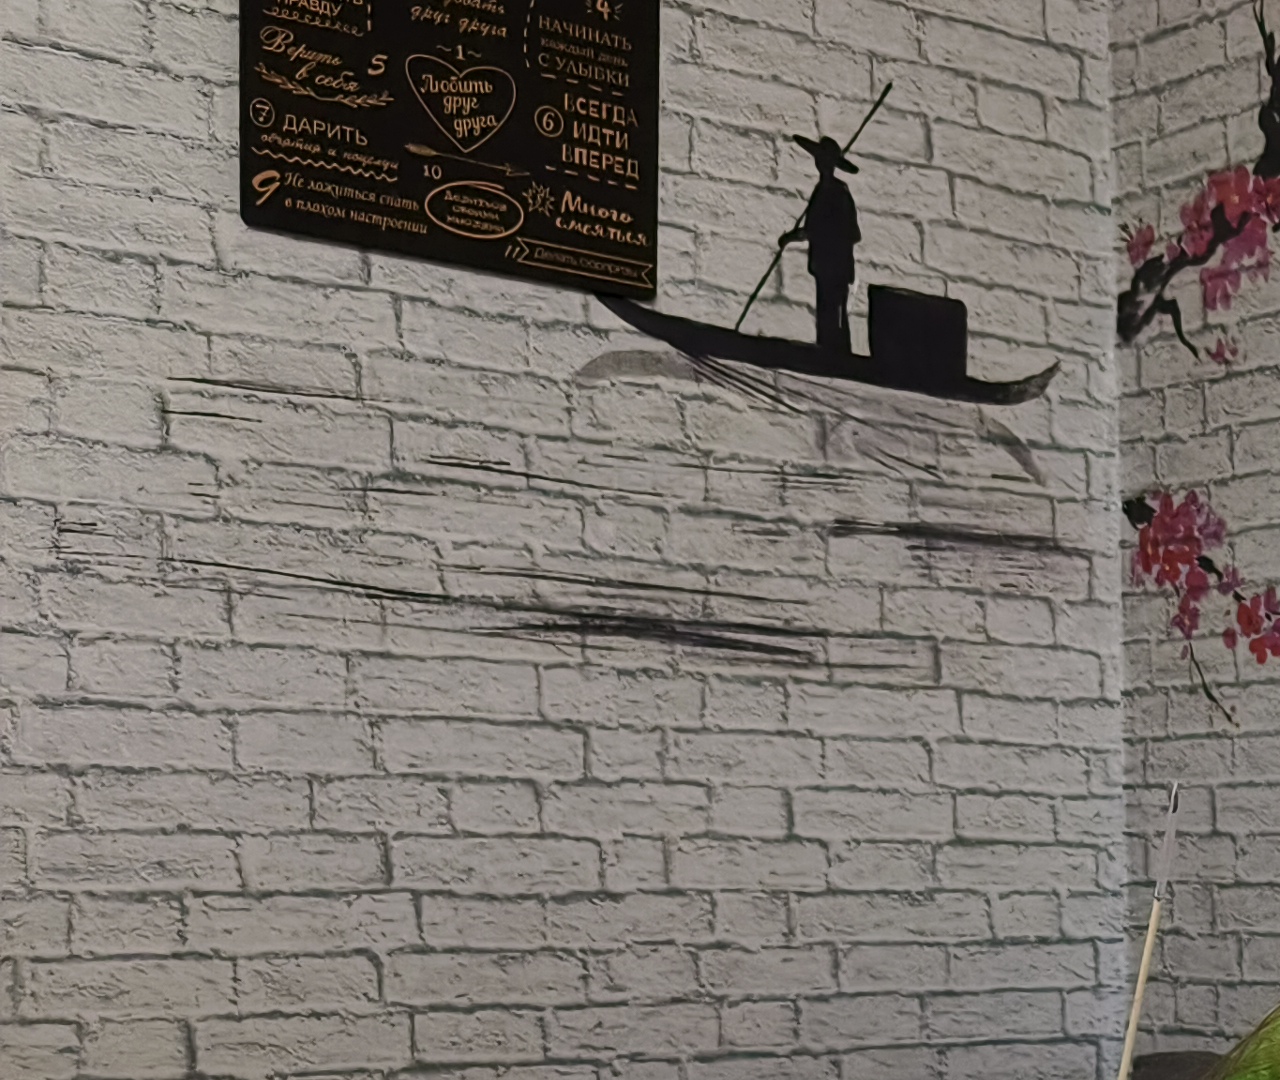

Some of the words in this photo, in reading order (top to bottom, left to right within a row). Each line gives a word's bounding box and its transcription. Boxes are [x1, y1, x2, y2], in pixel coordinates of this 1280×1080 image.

[278, 0, 342, 16] АВДУ
[596, 0, 611, 21] 4
[260, 26, 342, 66] Верить
[539, 15, 632, 51] НАЧИНАТЬ
[368, 54, 389, 75] 5
[556, 57, 629, 87] УЛЫБКИ
[315, 71, 360, 92] себя
[421, 74, 493, 93] Любить
[255, 104, 270, 122] 7
[443, 95, 479, 115] друг
[564, 93, 639, 127] ВСЕГДА
[283, 114, 368, 146] ДАРИТЬ
[454, 114, 498, 138] друга
[542, 112, 555, 131] 6
[573, 121, 629, 150] ИДТИ
[423, 165, 442, 180] 10
[562, 143, 640, 181] ВПЕРЕД
[251, 169, 281, 206] 9
[284, 172, 304, 188] Не
[307, 181, 376, 201] ложиться
[379, 194, 420, 211] спать
[285, 198, 292, 208] в
[296, 200, 346, 219] плохом
[349, 209, 428, 234] настроении
[560, 191, 634, 224] Много
[555, 217, 649, 247] смеяться
